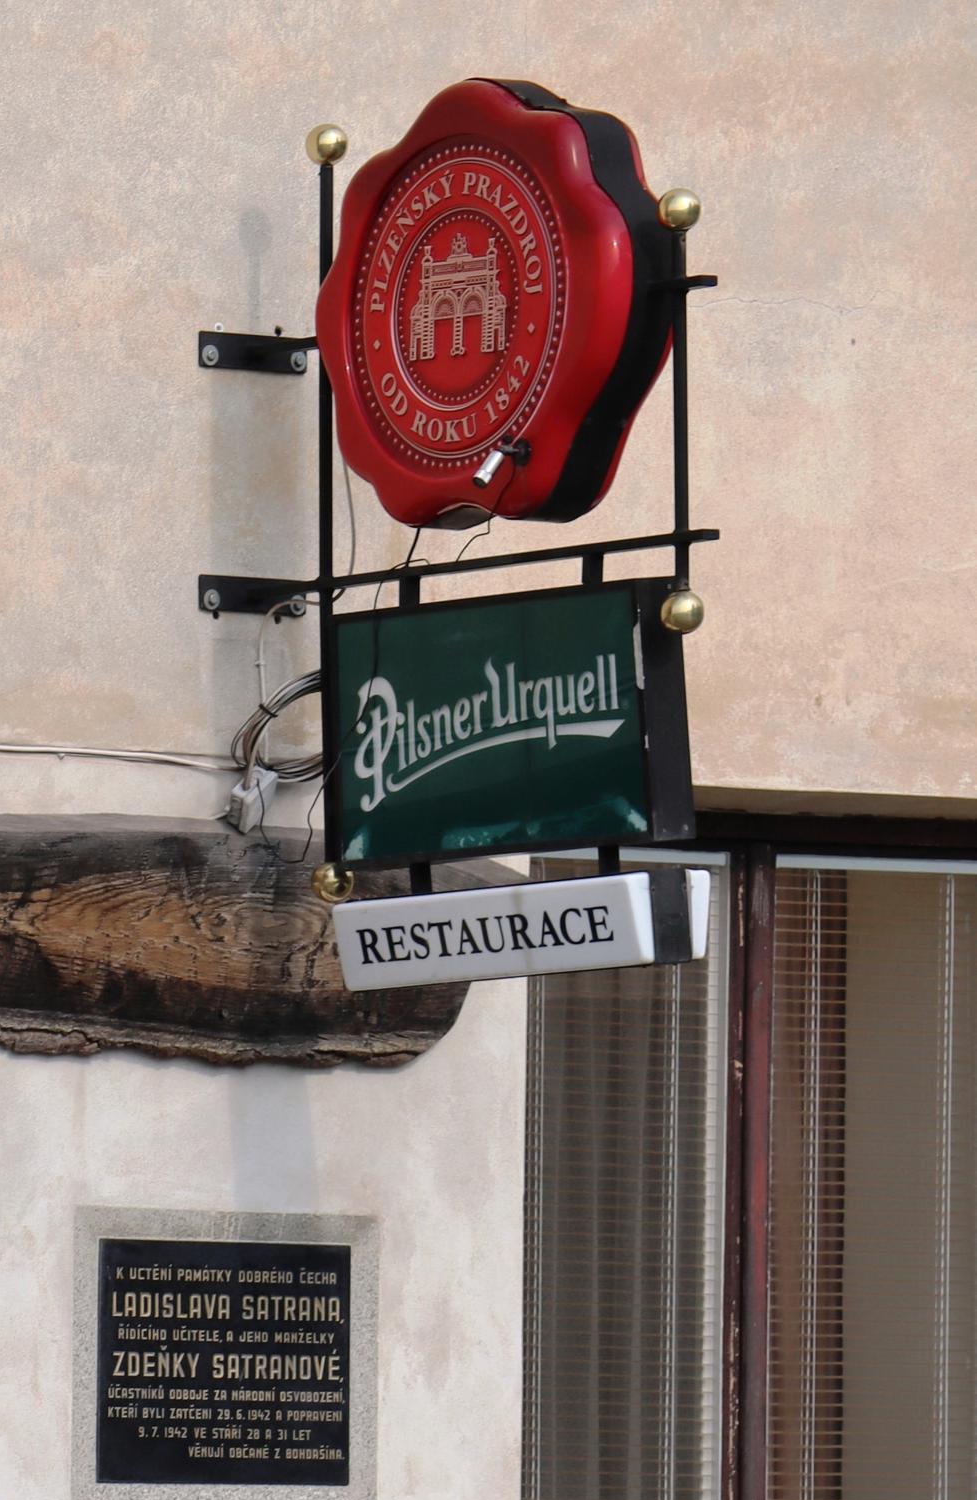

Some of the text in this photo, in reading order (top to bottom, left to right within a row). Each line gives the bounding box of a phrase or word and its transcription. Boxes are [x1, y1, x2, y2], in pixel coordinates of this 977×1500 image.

[370, 168, 544, 312] PLZEŇSKÝ PRAZDROJ
[379, 353, 532, 444] OD ROKU 1842
[354, 652, 623, 813] Pilsner Urquell
[356, 904, 615, 965] RESTAURACE
[116, 1266, 124, 1280] K
[177, 1265, 232, 1283] PAMÁTKY
[238, 1267, 294, 1284] DOBRÉHO
[299, 1267, 338, 1285] ČECHA
[111, 1291, 345, 1325] LADISLAVA SATRANA,
[118, 1323, 335, 1345] ŘÍDÍCÍHO UČITELE, A JEHO MANŽELKY
[112, 1345, 344, 1384] ZDEŇKY SATRANOVÉ,
[108, 1383, 346, 1404] ÚČASTNÍKŮ ODBOJE ZA NÁRODNÍ OSVOBOZENÍ,
[107, 1403, 138, 1419] KTEŘÍ
[142, 1407, 165, 1419] BYLI
[169, 1404, 212, 1420] ZATČENI
[275, 1410, 283, 1421] A
[287, 1410, 343, 1422] POPRAVENI
[194, 1427, 207, 1439] VE
[212, 1424, 242, 1439] STÁŘÍ
[265, 1428, 272, 1440] A
[277, 1429, 287, 1441] 31
[292, 1429, 311, 1441] LET
[188, 1442, 224, 1458] VĚNUJÍ
[229, 1444, 270, 1459] OBČANÉ
[274, 1448, 281, 1459] Z
